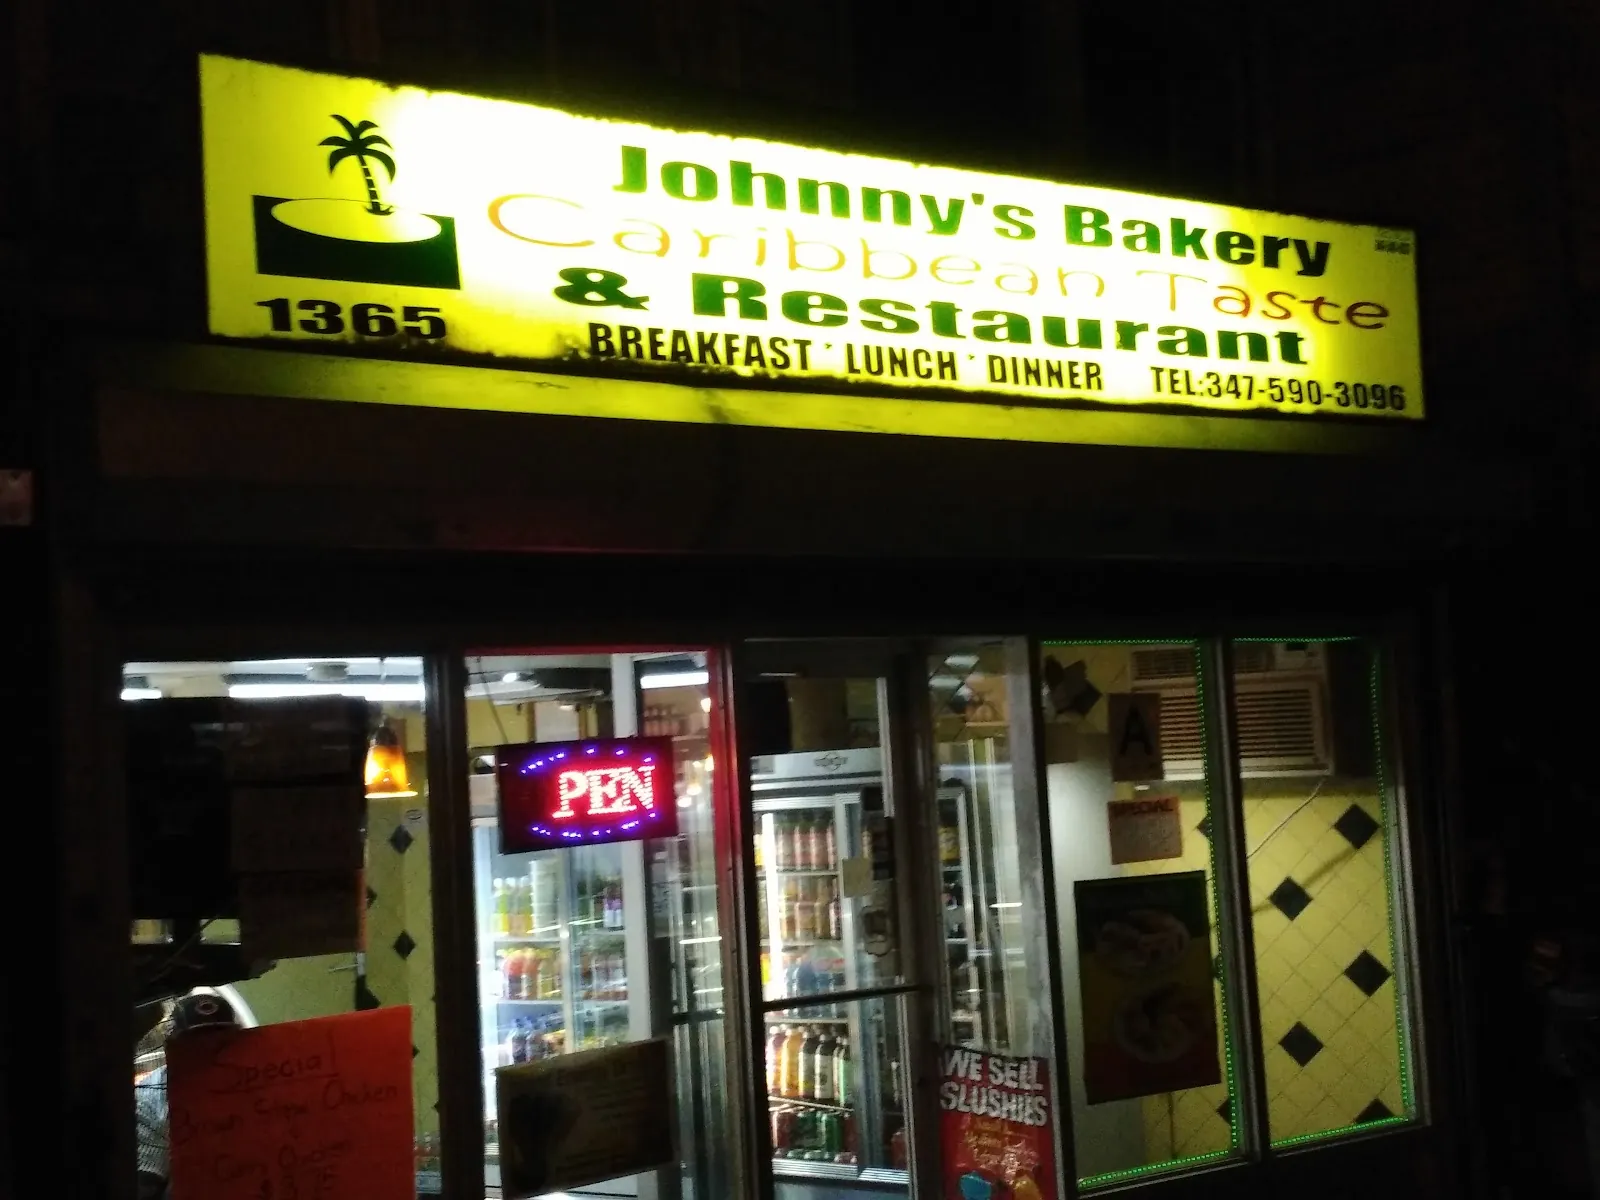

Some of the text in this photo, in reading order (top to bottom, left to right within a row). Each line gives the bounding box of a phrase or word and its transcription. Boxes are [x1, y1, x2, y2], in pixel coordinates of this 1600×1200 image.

[612, 144, 1331, 278] Johnny's Bakery
[487, 192, 1390, 330] Caribbean Taste
[254, 298, 447, 340] 1365
[553, 266, 1308, 366] & Restaurant
[588, 322, 1104, 390] BREAKFAST LUNCH DINNER
[1149, 365, 1407, 411] TEL:347-590-3096
[1118, 702, 1153, 756] A
[938, 1049, 1044, 1091] WE SELL
